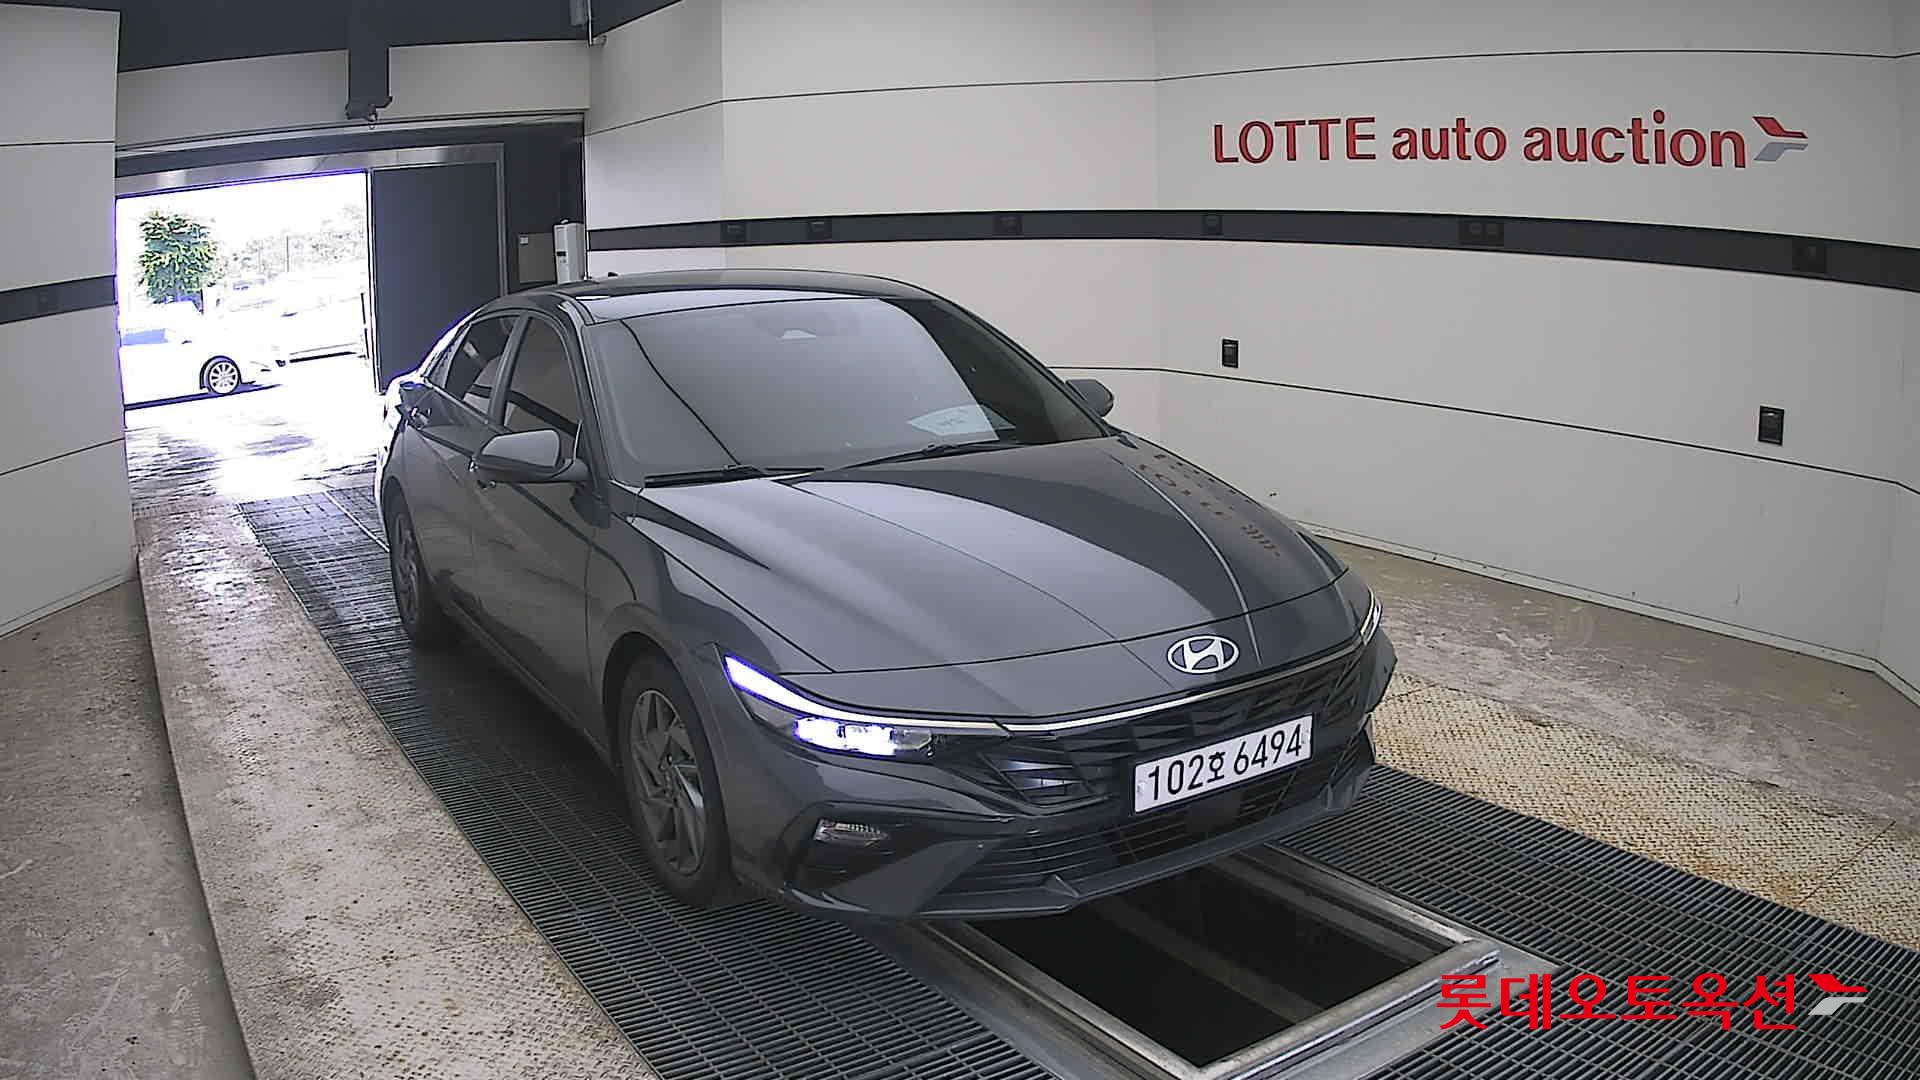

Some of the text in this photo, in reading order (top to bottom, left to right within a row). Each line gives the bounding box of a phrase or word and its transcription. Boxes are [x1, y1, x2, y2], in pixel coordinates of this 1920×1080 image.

[1213, 109, 1746, 168] LOTTE auto auction
[1148, 723, 1302, 801] 102호 6494
